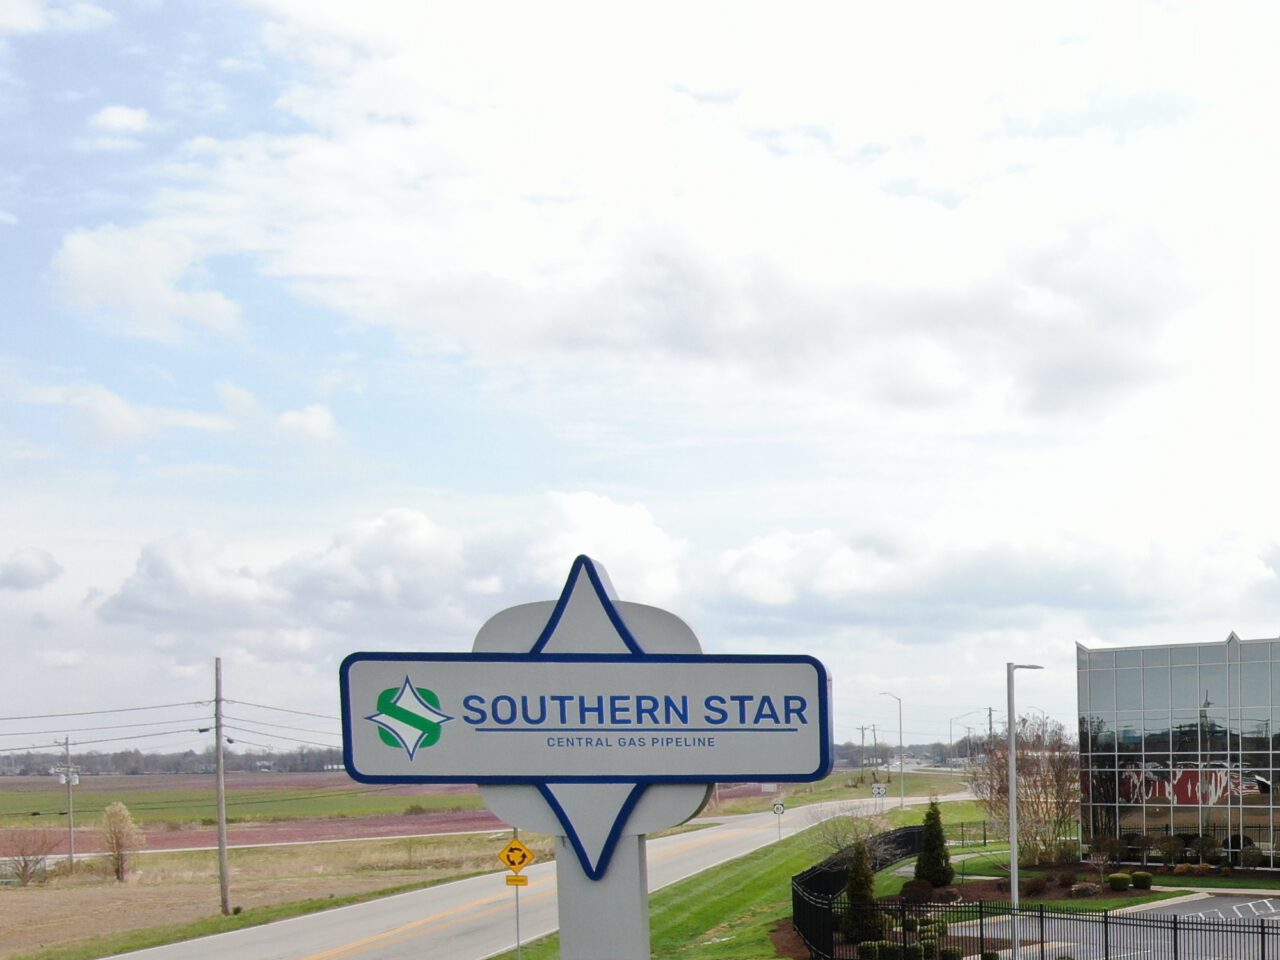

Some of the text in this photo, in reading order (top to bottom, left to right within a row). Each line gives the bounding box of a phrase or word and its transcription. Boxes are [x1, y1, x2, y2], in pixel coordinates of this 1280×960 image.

[462, 694, 808, 725] SOUTHERN STAR
[547, 737, 716, 747] CENTRAL GAS PIPELINE
